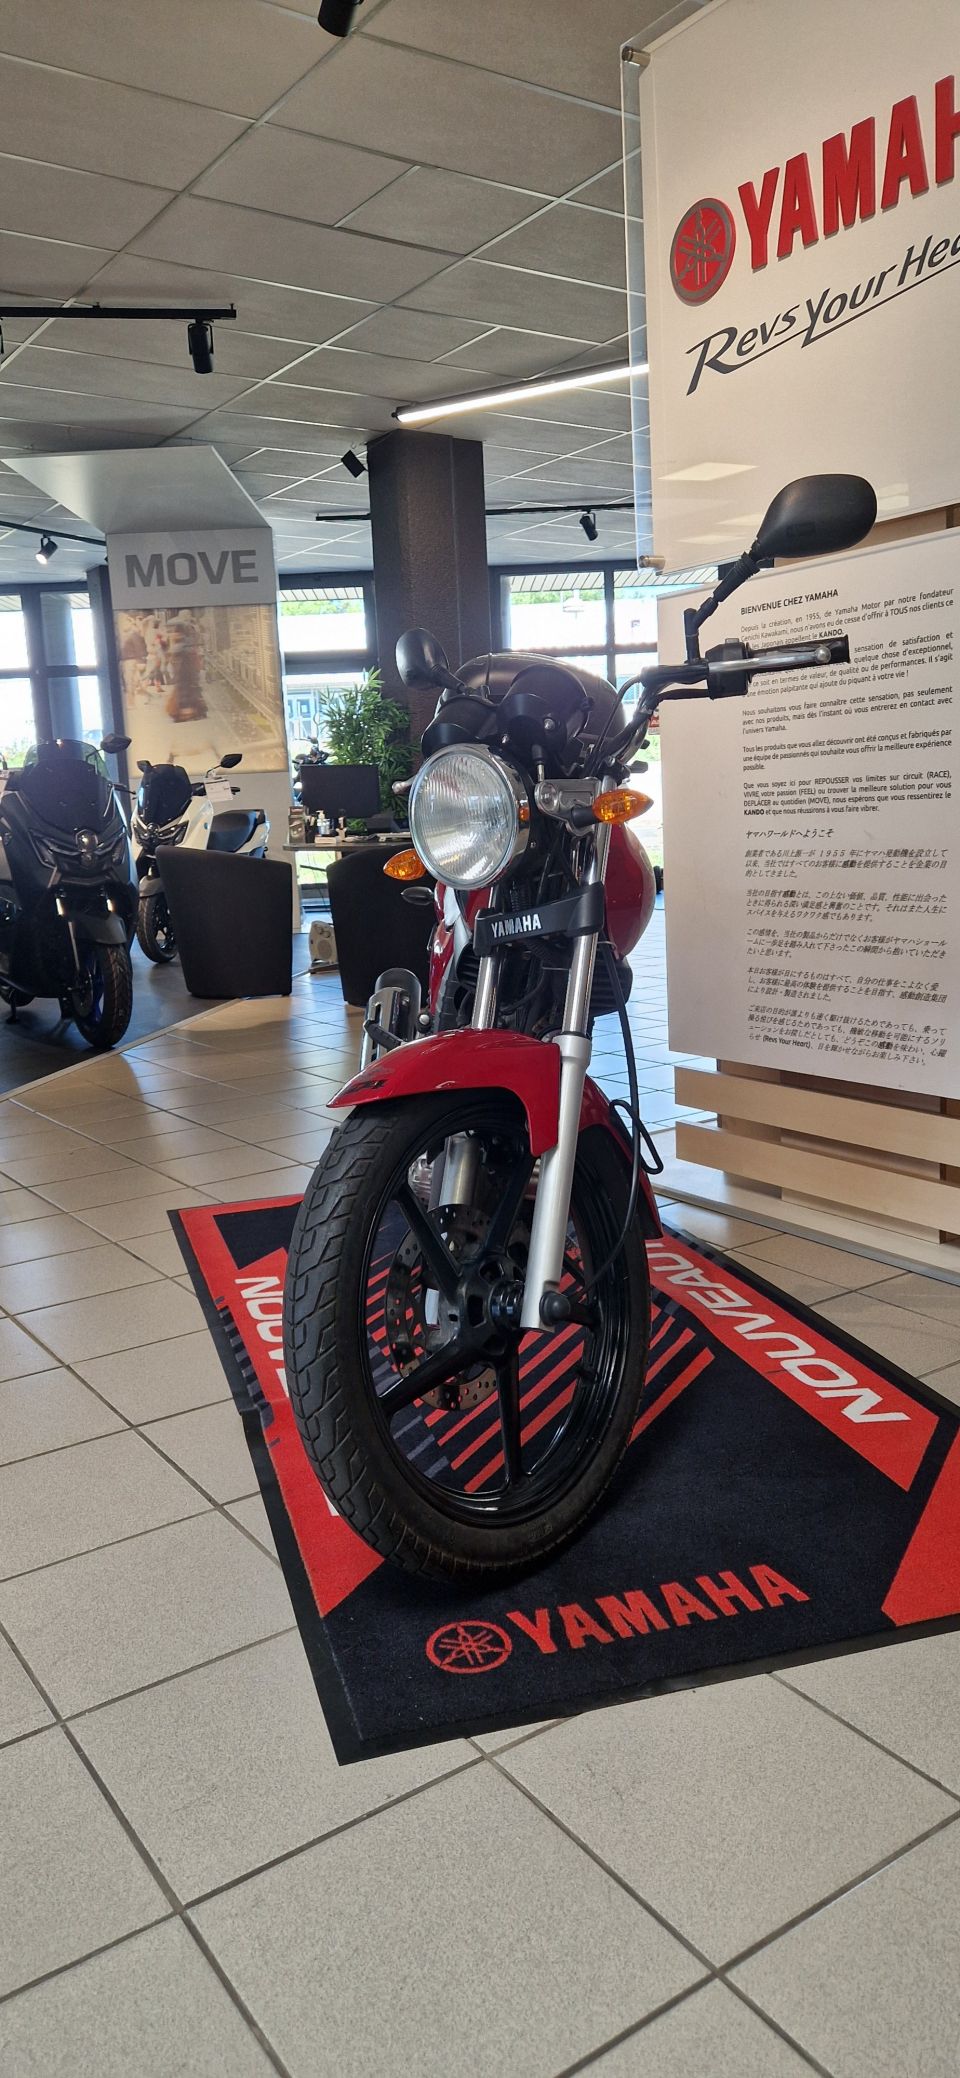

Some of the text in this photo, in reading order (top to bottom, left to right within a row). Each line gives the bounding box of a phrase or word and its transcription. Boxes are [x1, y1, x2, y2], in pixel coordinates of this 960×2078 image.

[685, 304, 800, 396] Revs
[801, 264, 897, 348] Your
[125, 550, 258, 588] MOVE
[741, 589, 838, 615] BIENVENUE CHEZ YAMAHA
[835, 606, 858, 615] Yamaha
[862, 602, 880, 610] Motor
[884, 599, 894, 607] par
[898, 596, 916, 604] notre
[920, 588, 954, 600] fondateur
[790, 626, 803, 634] nous
[844, 616, 860, 624] cesse
[891, 606, 908, 616] TOUS
[922, 601, 944, 610] clients
[819, 629, 844, 638] KANDO.
[854, 643, 883, 653] sensation
[902, 634, 940, 645] satisfaction
[839, 666, 859, 676] qualité
[881, 659, 926, 671] performances.
[935, 653, 953, 663] s'agit
[854, 655, 878, 664] quelque
[882, 651, 899, 659] chose
[820, 680, 838, 689] ajoute
[848, 676, 871, 686] piquant
[758, 706, 786, 715] souhaitons
[804, 701, 817, 709] faire
[903, 691, 914, 699] pas
[917, 686, 953, 696] seulement
[819, 709, 842, 717] l'instant
[871, 703, 897, 711] entrerez
[910, 699, 935, 707] contact
[764, 742, 786, 752] produits
[826, 738, 853, 746] découvrir
[878, 734, 899, 742] conçus
[909, 729, 939, 739] fabriqués
[941, 729, 952, 737] par
[780, 750, 809, 760] passionnés
[821, 748, 844, 756] souhaite
[885, 742, 914, 751] meilleure
[916, 739, 952, 748] expérience
[772, 781, 786, 790] soyez
[927, 770, 952, 779] (RACE),
[777, 789, 796, 797] passion
[799, 787, 816, 796] (FEEL)
[859, 784, 887, 792] meilleure
[918, 782, 933, 790] pour
[781, 798, 806, 806] quotidien
[907, 792, 943, 800] ressentirez
[746, 829, 834, 838] ヤマハワールドへようこそ
[491, 913, 541, 938] YAMAHA
[645, 1242, 911, 1424] NOUVEAU
[506, 1564, 810, 1654] YAMAHA
